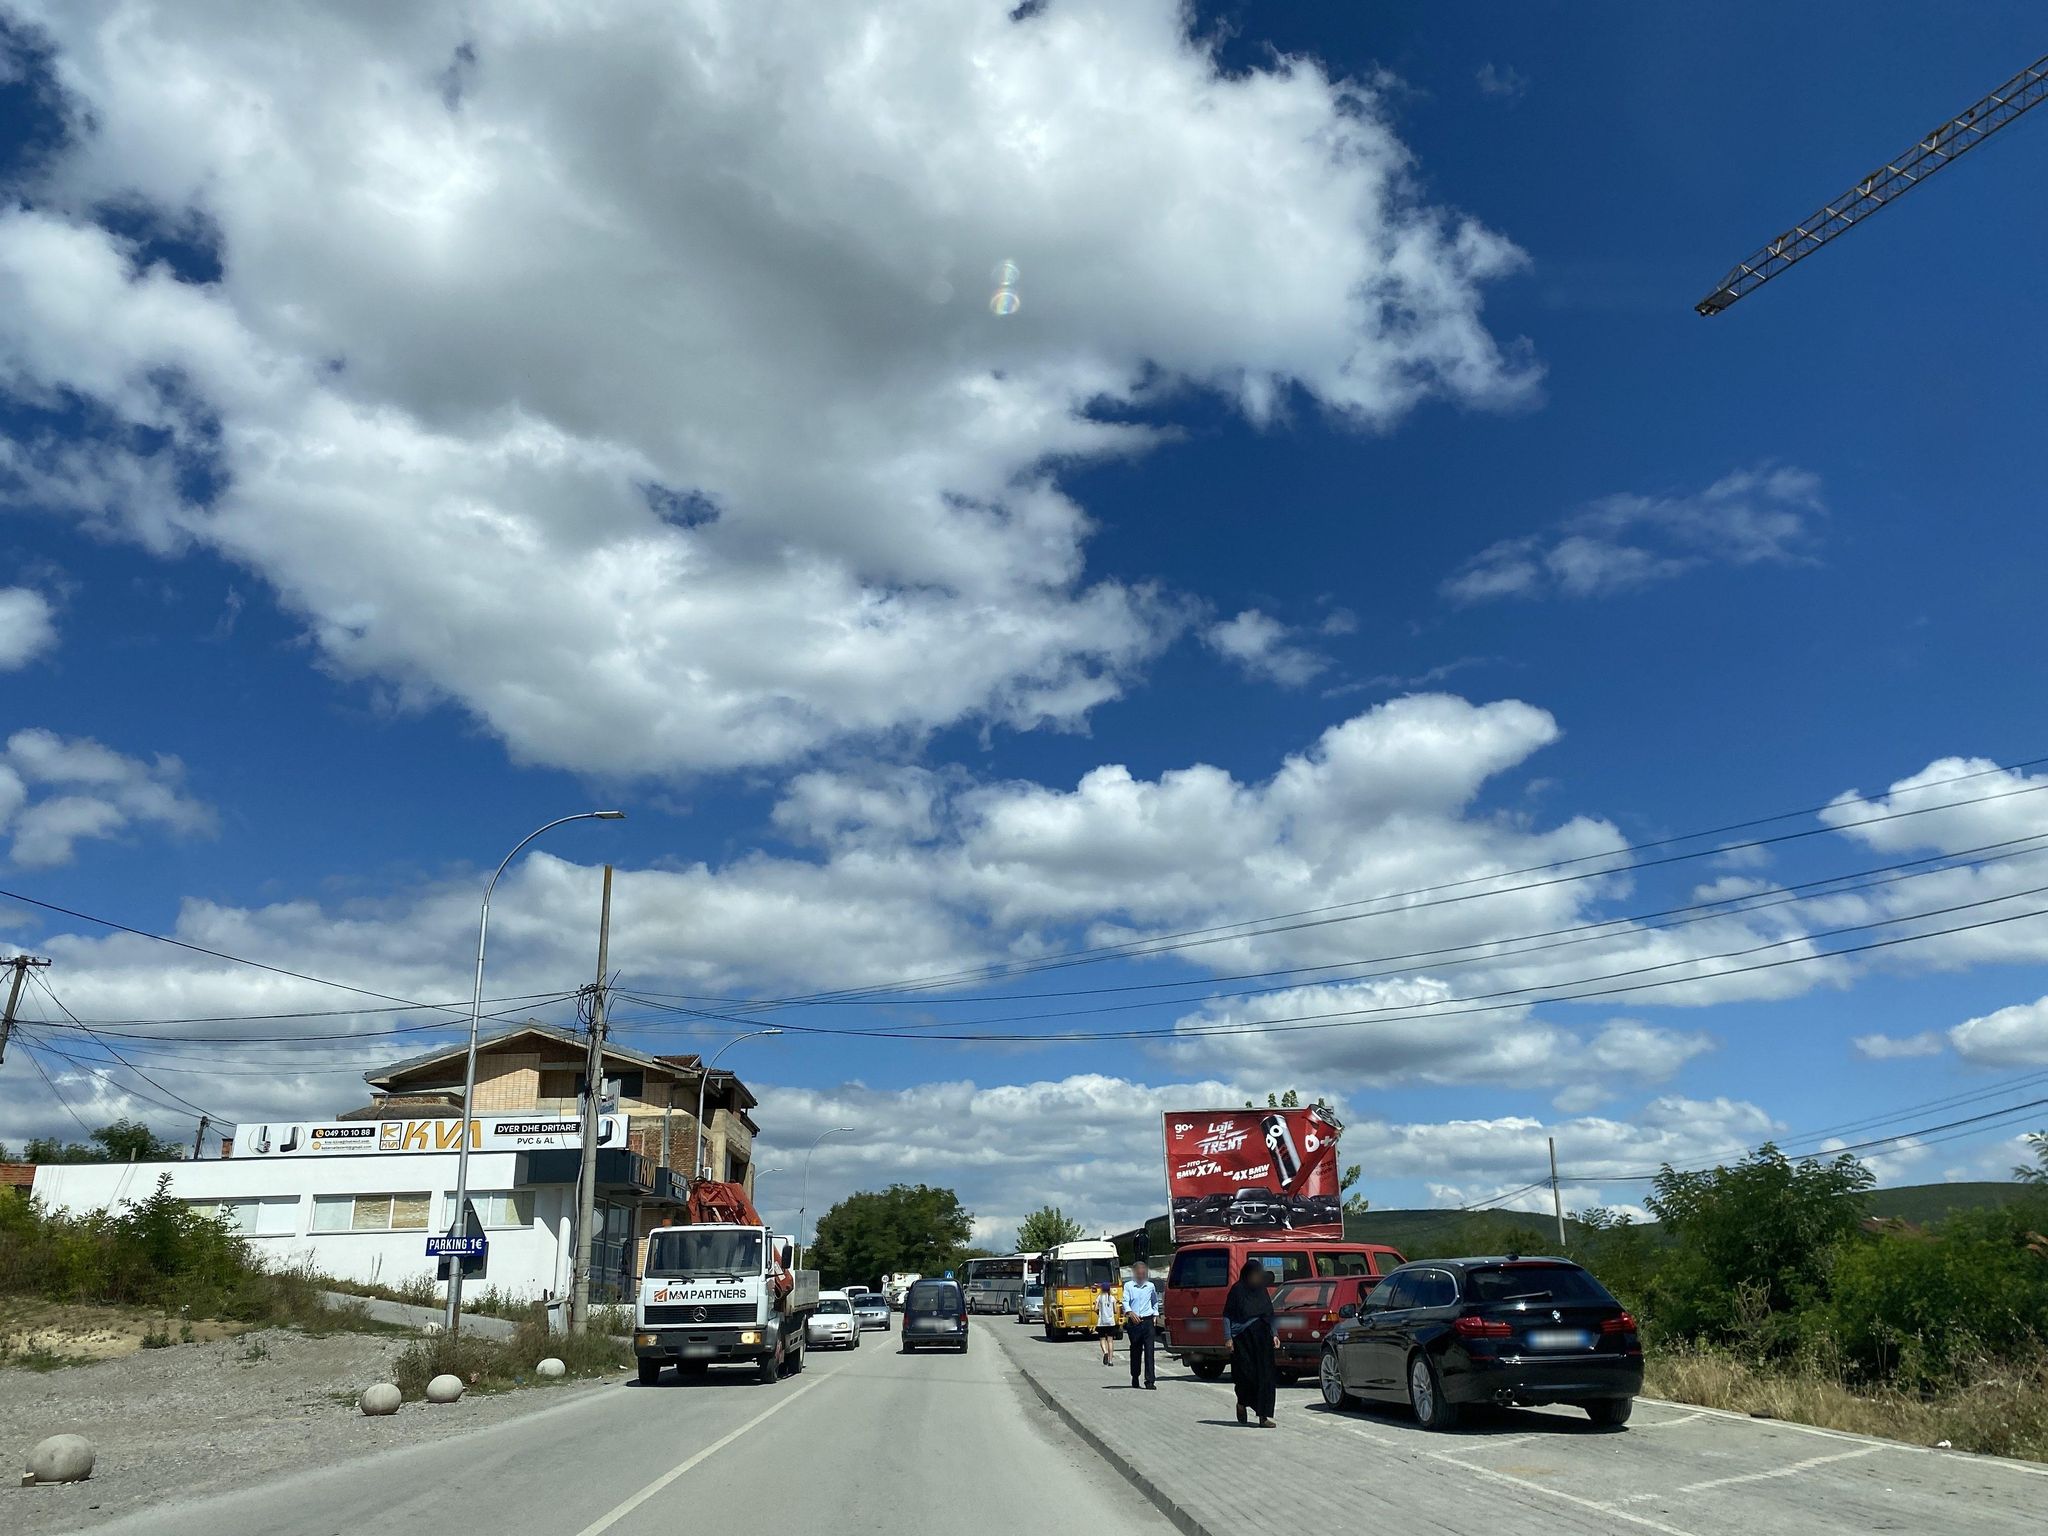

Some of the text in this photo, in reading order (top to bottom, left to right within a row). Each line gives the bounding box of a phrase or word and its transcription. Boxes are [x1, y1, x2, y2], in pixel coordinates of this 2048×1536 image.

[325, 1129, 339, 1137] 049
[497, 1123, 577, 1133] DYER DHE DRITARE
[401, 1120, 481, 1149] KVA
[1199, 1135, 1248, 1155] TRENT
[1176, 1168, 1197, 1179] BMW
[1248, 1164, 1270, 1175] BMW
[429, 1238, 483, 1250] PARKING 1€
[690, 1289, 747, 1299] PARTNERS
